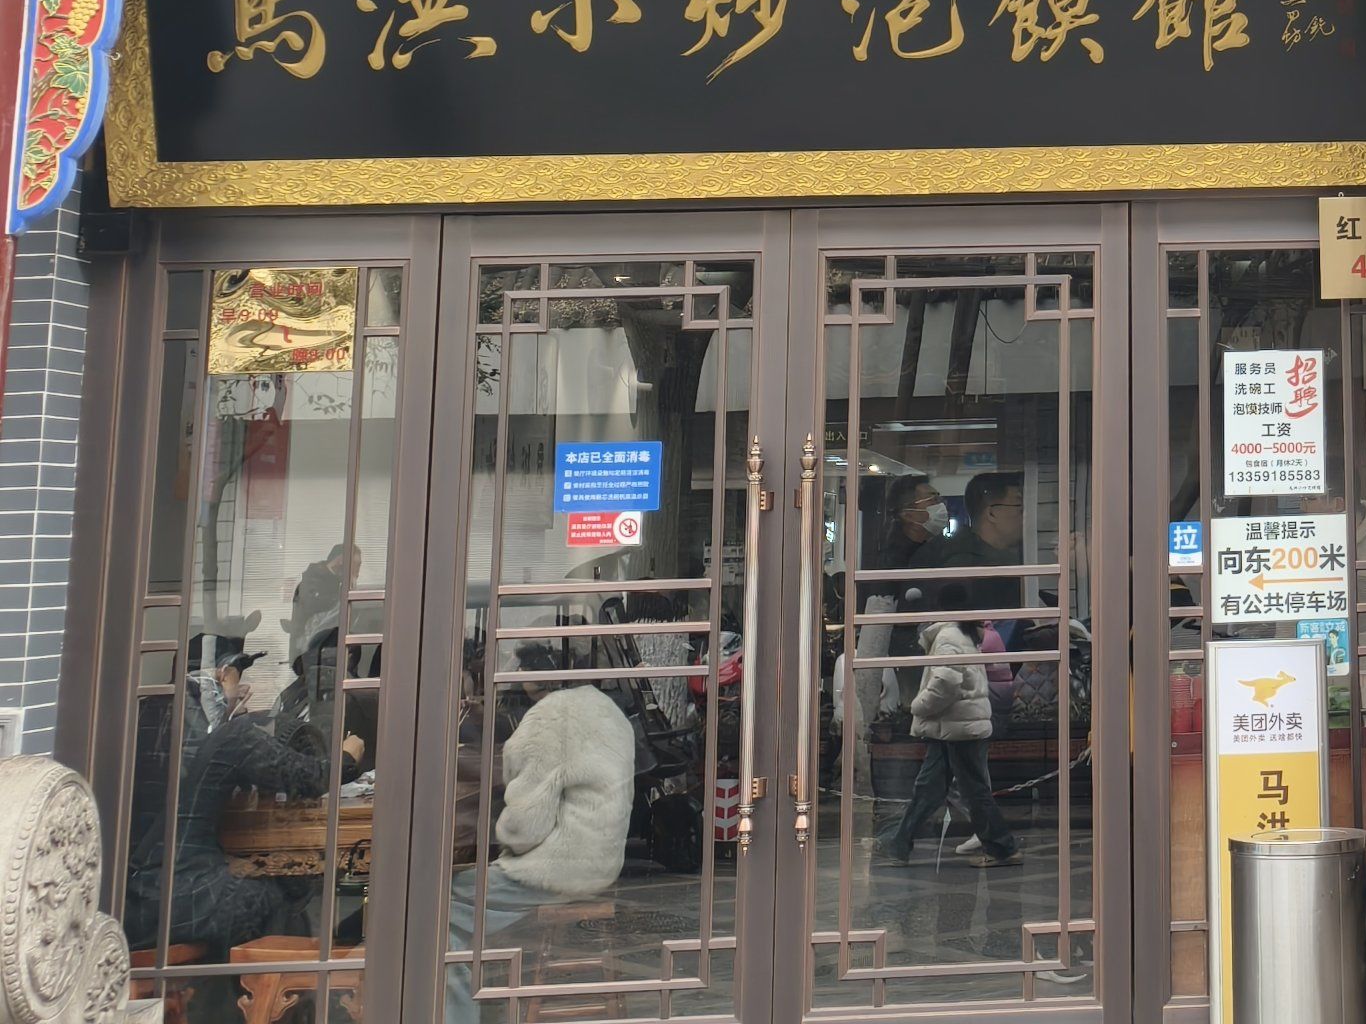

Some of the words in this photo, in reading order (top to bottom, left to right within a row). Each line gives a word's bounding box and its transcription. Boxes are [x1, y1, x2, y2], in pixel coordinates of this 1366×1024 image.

[1234, 362, 1276, 375] 服务员
[1234, 382, 1276, 395] 洗碗工
[1285, 355, 1319, 419] 招聘
[1233, 402, 1283, 415] 泡馍技师
[1261, 422, 1291, 437] 工资
[565, 450, 650, 465] 本店已全面消毒
[1229, 470, 1320, 482] 13359185583
[1173, 525, 1198, 550] 拉
[1246, 521, 1316, 540] 温馨提示
[1217, 544, 1346, 575] 向东200米
[1220, 591, 1347, 615] 有公共停车场
[1233, 712, 1303, 732] 美团外卖
